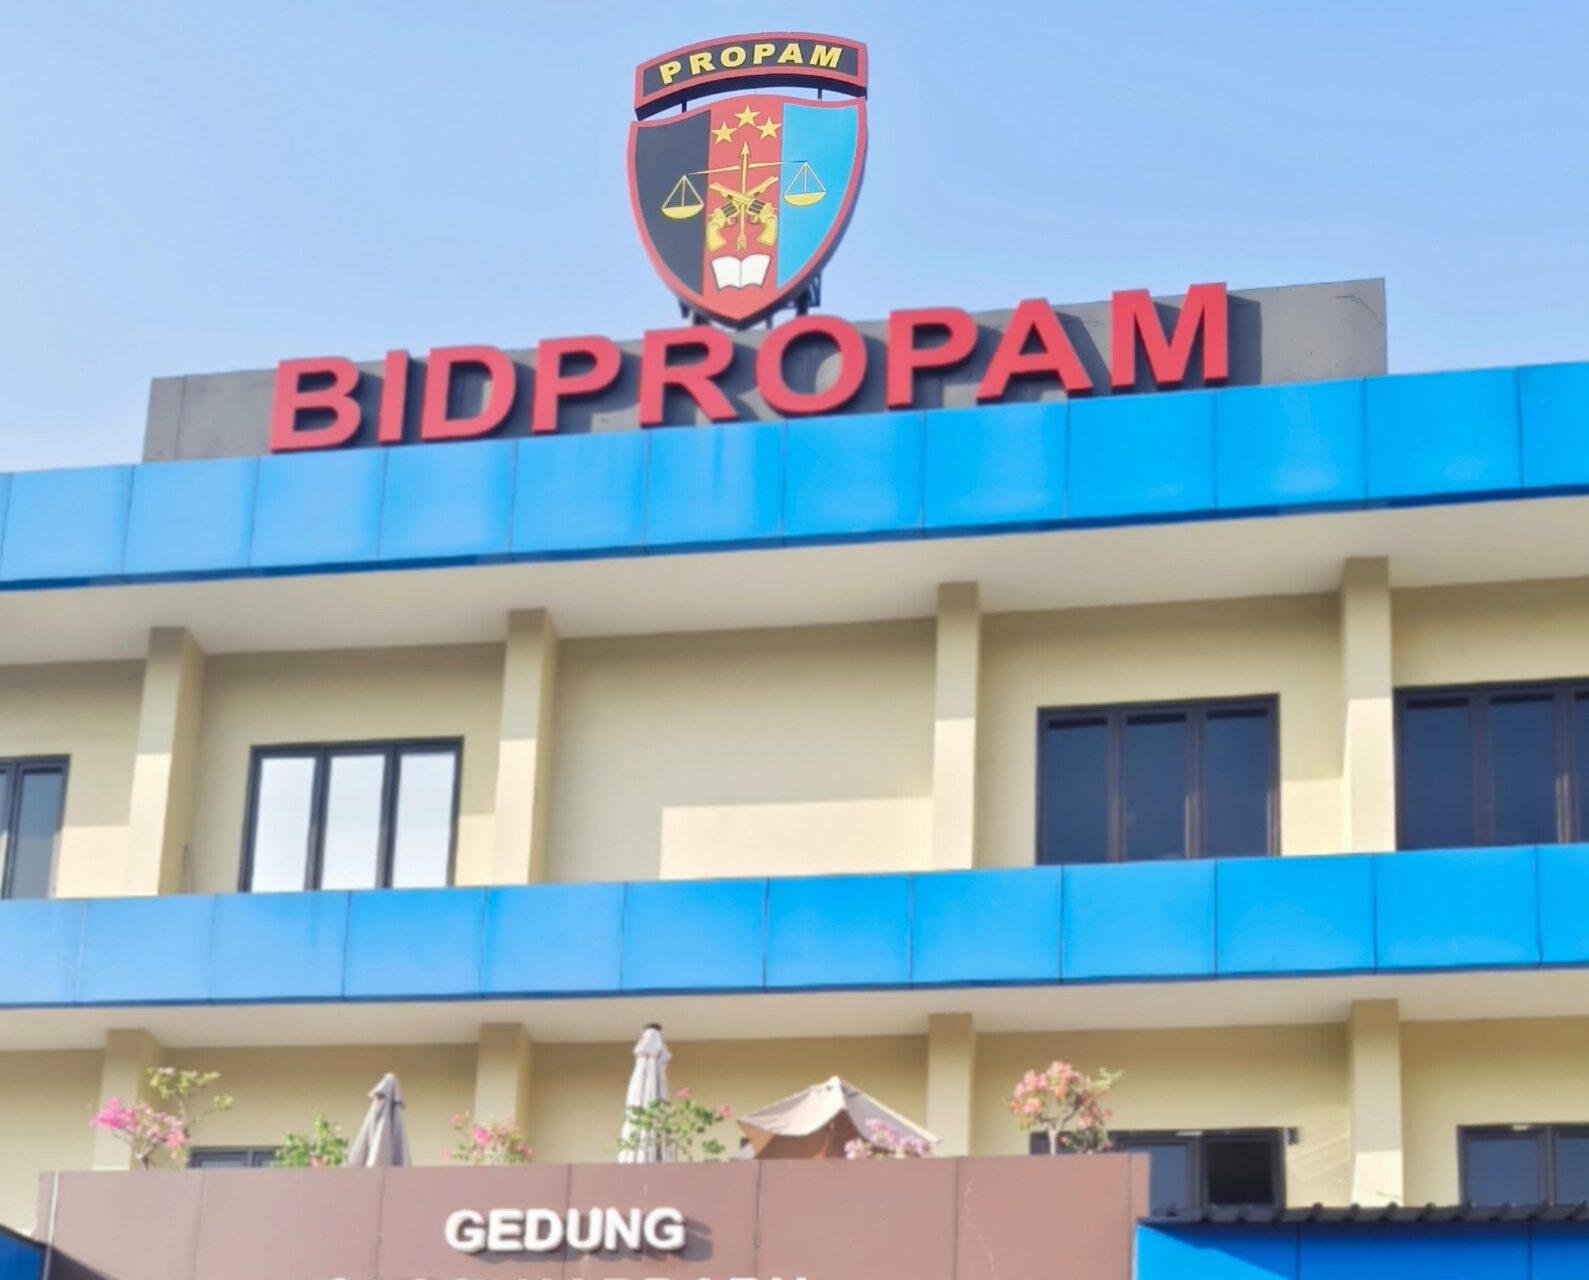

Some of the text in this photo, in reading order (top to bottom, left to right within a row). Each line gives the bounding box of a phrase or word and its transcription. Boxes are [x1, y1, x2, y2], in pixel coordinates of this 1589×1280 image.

[659, 43, 842, 85] PROPAM
[270, 281, 1229, 453] BIDPROPAM
[444, 1207, 687, 1253] GEDUNG
